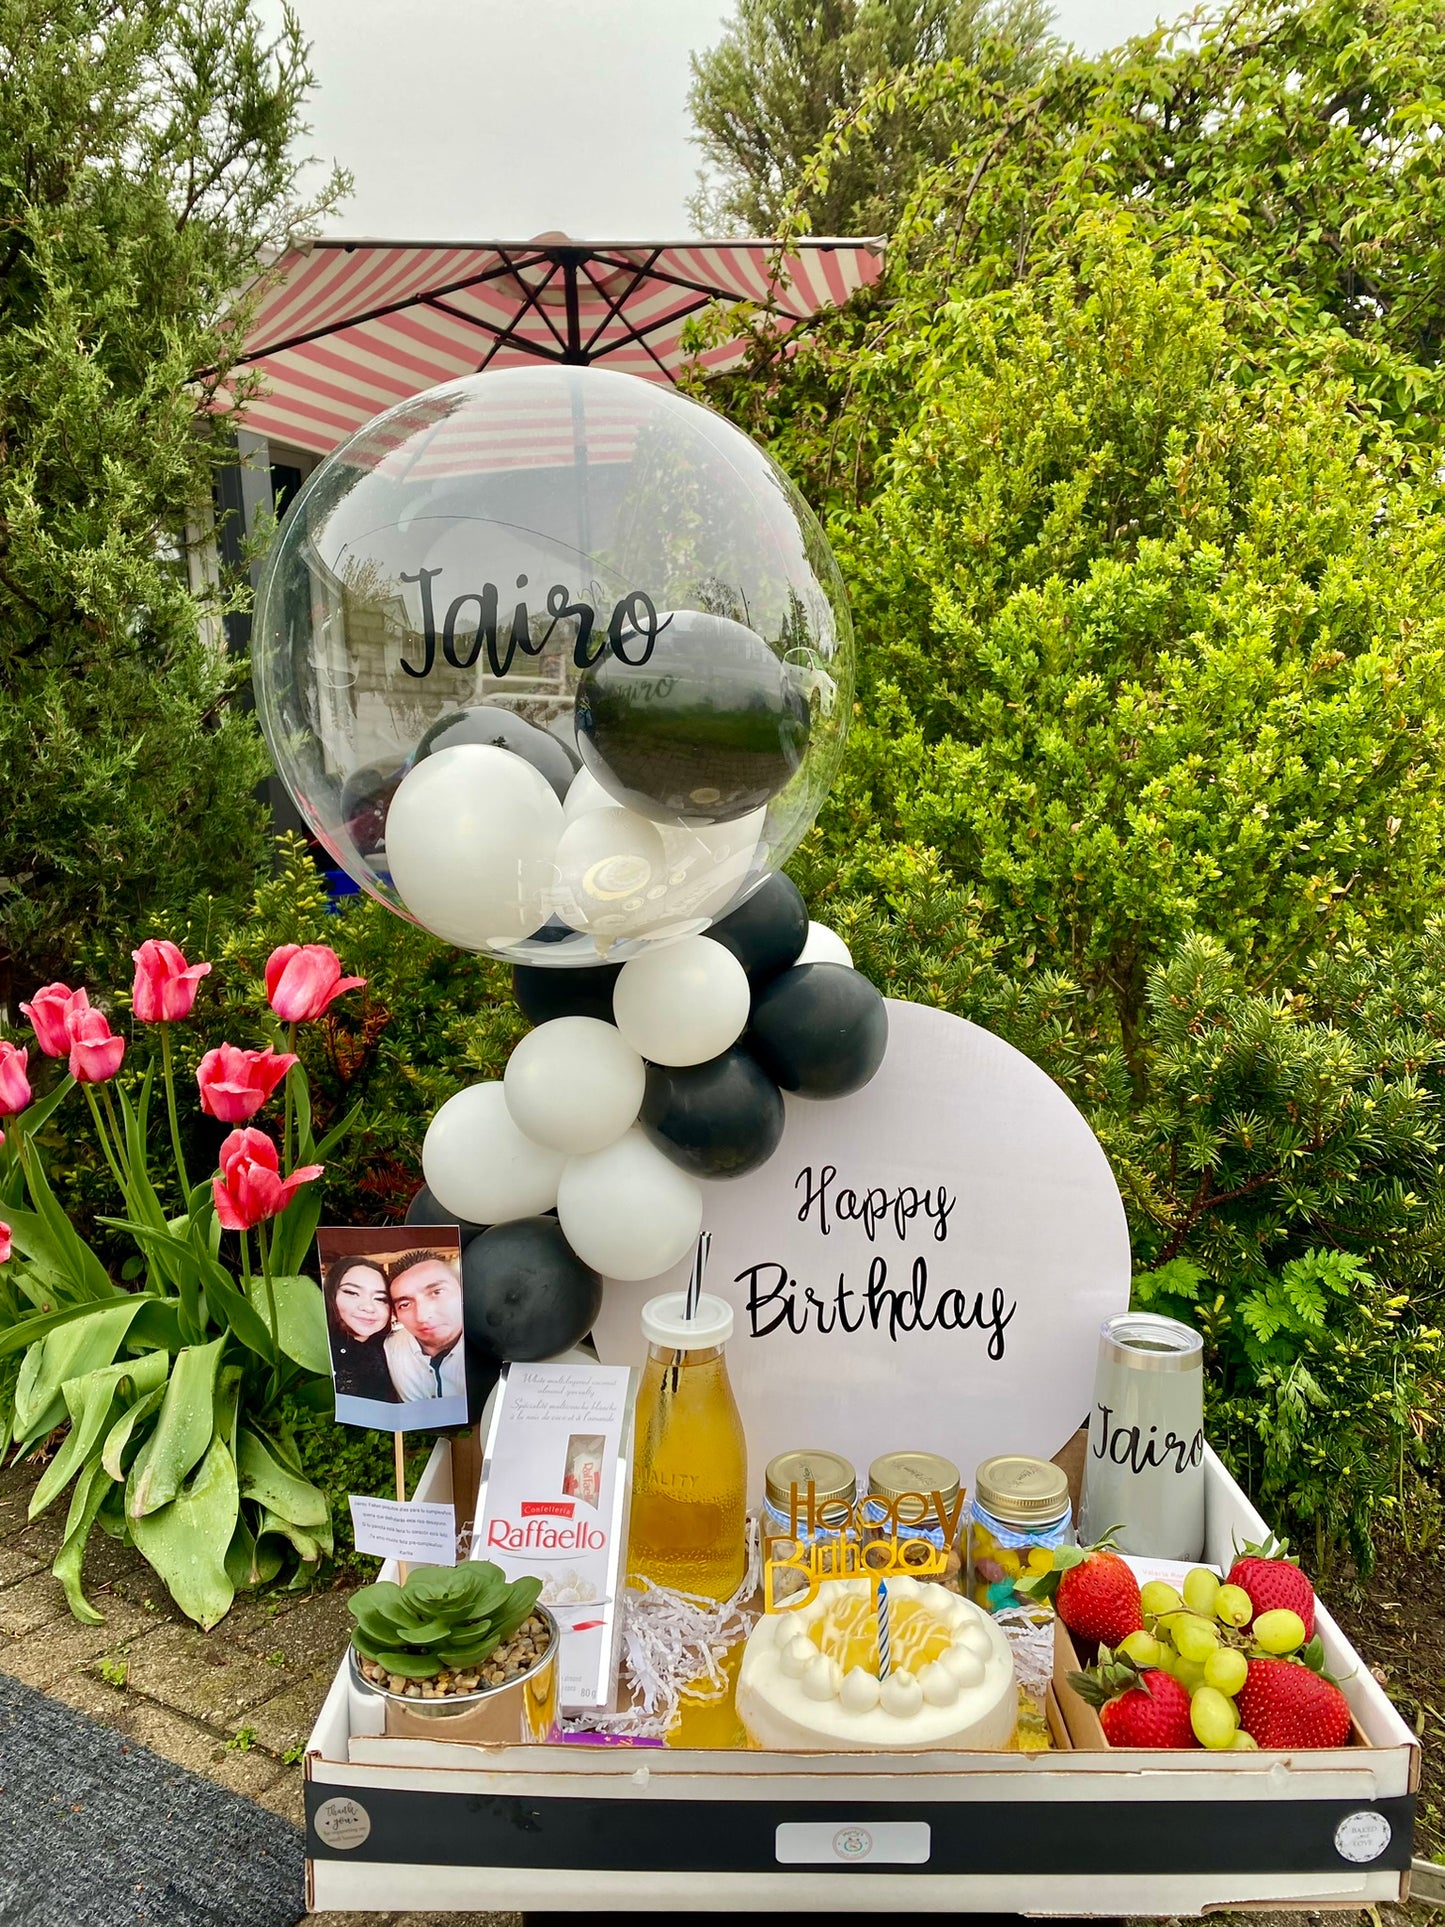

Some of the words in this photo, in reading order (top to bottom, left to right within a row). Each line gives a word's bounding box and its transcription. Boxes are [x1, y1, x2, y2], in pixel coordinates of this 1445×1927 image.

[400, 567, 674, 678] Jairo
[795, 1165, 956, 1242] Happy
[733, 1256, 1017, 1361] Birthday
[1093, 1402, 1204, 1474] Jairo
[582, 1462, 594, 1503] Raffaell
[524, 1505, 571, 1515] Confetteria
[789, 1479, 967, 1548] Happy
[488, 1519, 606, 1551] Raffaello
[580, 1687, 591, 1698] 80
[325, 1801, 359, 1817] Thank
[332, 1816, 354, 1831] you
